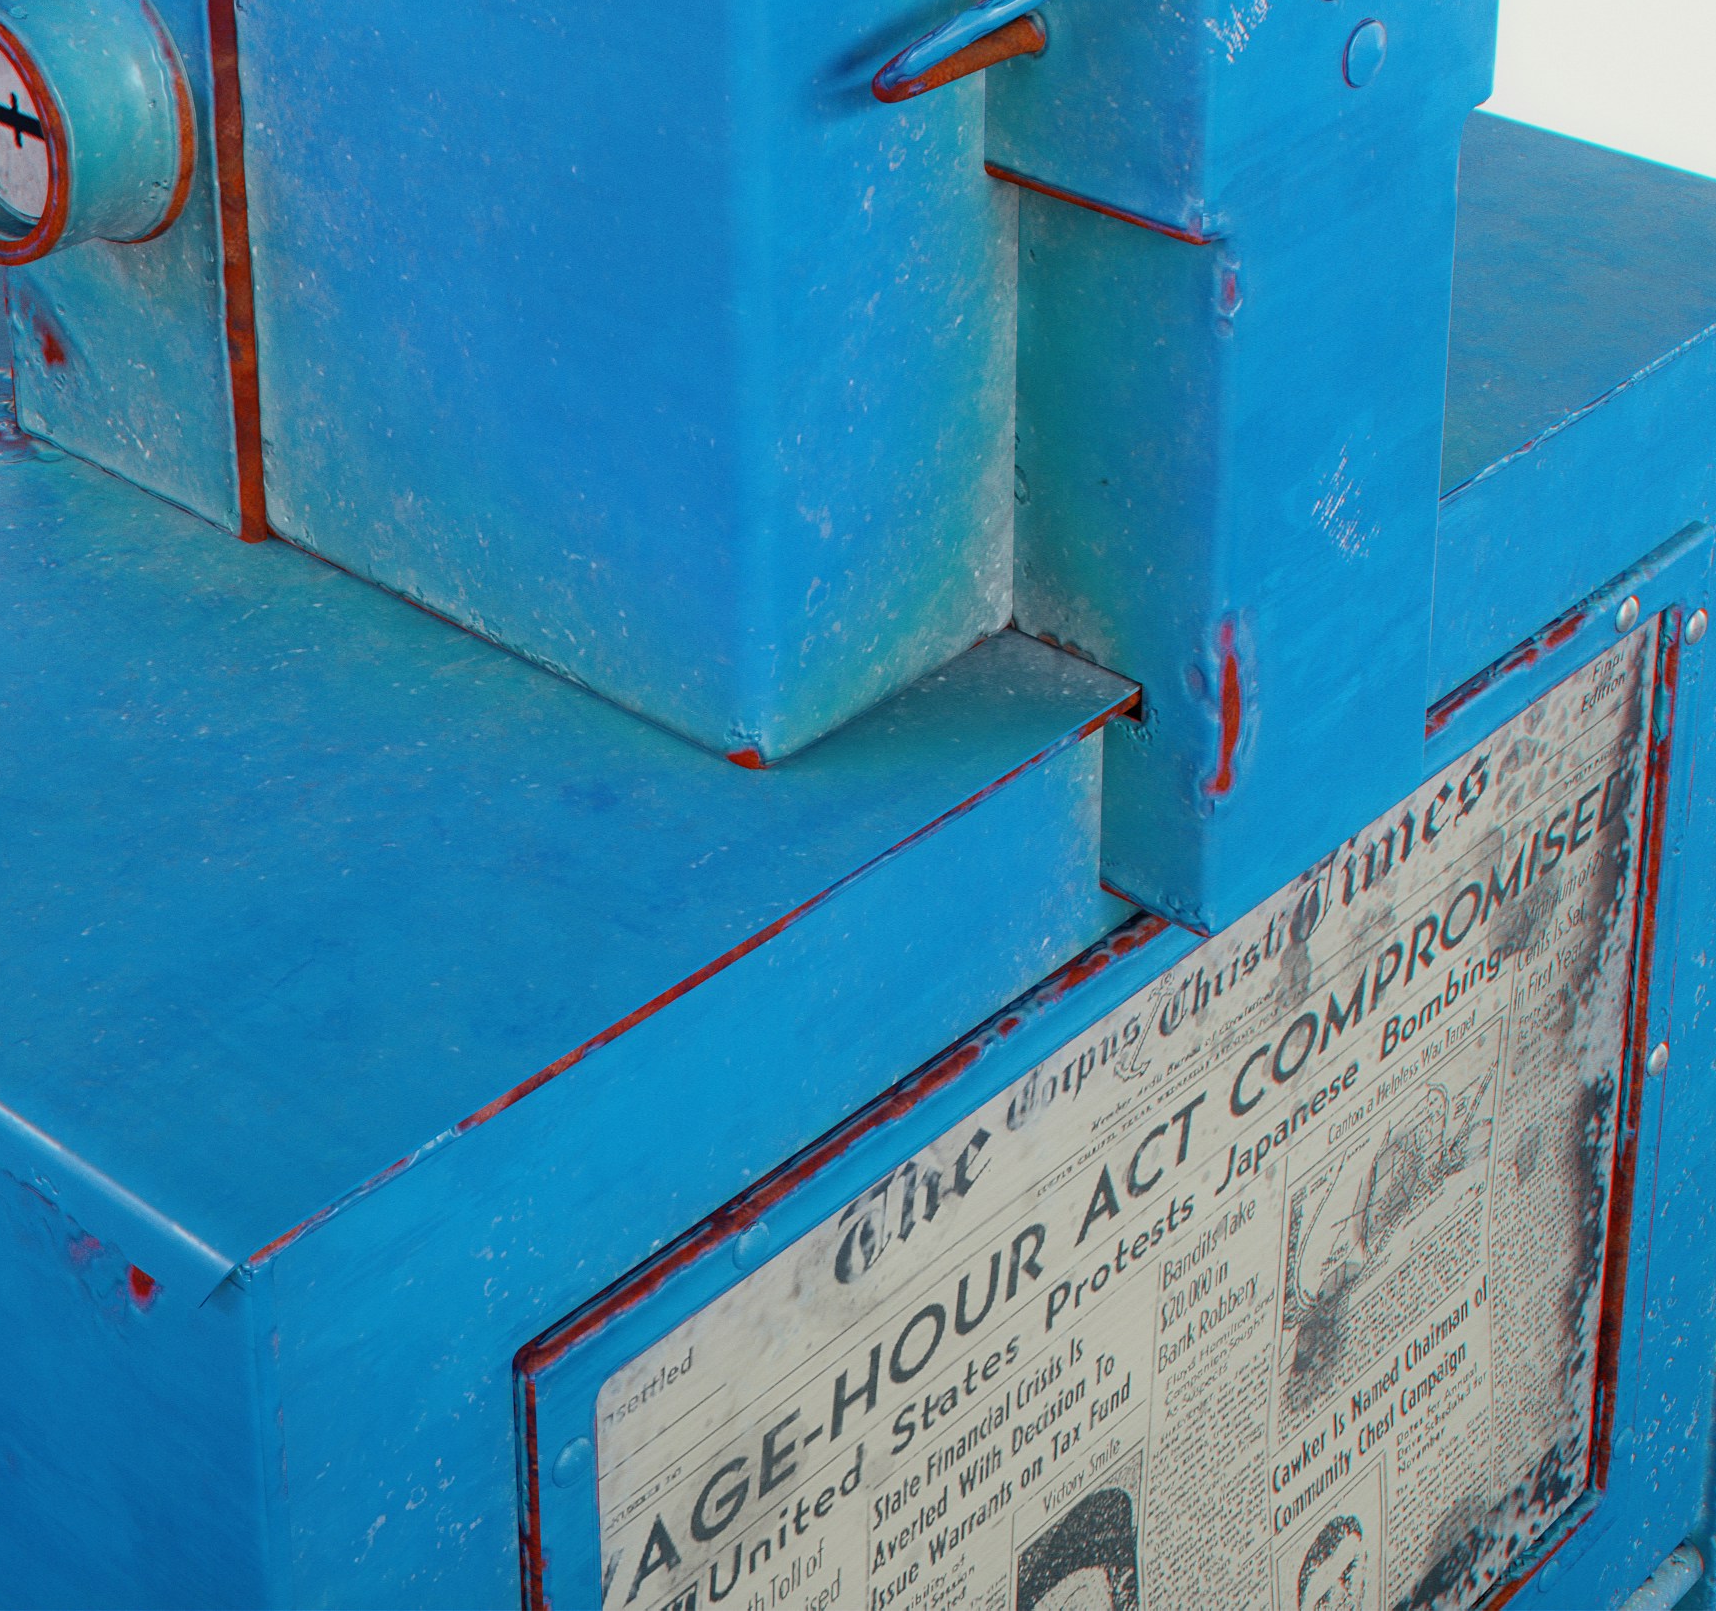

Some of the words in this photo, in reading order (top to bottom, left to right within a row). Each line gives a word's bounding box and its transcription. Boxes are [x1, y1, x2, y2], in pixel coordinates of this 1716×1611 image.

[1581, 671, 1626, 714] Edition
[1591, 651, 1624, 682] Final
[834, 1127, 992, 1284] The
[1005, 1012, 1142, 1131] Corpus
[1159, 911, 1286, 1037] Christi
[1289, 744, 1492, 943] Times
[1074, 1090, 1207, 1247] ACT
[1230, 764, 1629, 1118] COMPROMISED
[1514, 983, 1524, 1012] In
[1528, 960, 1553, 999] First
[1327, 1103, 1364, 1145] Canton
[1366, 1097, 1374, 1114] a
[1375, 1059, 1419, 1107] Helpless
[1421, 1040, 1442, 1069] War
[1444, 1008, 1477, 1050] Target
[1162, 1228, 1218, 1292] Bandits
[1223, 1198, 1256, 1241] Take
[708, 1442, 864, 1603] United
[891, 1335, 1020, 1454] States
[1045, 1194, 1195, 1333] Protests
[1214, 1061, 1360, 1197] Japanese
[1158, 1320, 1195, 1374] Bank
[1198, 1271, 1260, 1339] Robbery
[1161, 1266, 1213, 1334] $20,000
[1215, 1260, 1229, 1288] in
[601, 1345, 694, 1432] nsettled
[872, 1474, 921, 1531] State
[926, 1390, 1011, 1487] Financial
[1016, 1353, 1063, 1411] Crisis
[1069, 1337, 1084, 1368] Is
[1272, 1430, 1327, 1493] Cawker
[1332, 1411, 1346, 1440] Is
[1350, 1356, 1401, 1423] Named
[1404, 1300, 1470, 1372] Chairman
[1473, 1273, 1489, 1309] of
[871, 1485, 948, 1576] Averted
[958, 1443, 1003, 1499] With
[1011, 1377, 1085, 1458] Decision
[1095, 1352, 1114, 1387] To
[1043, 1469, 1084, 1514] Victory
[1089, 1438, 1122, 1478] Smile
[1273, 1446, 1353, 1535] Community
[1357, 1400, 1395, 1457] Chest
[1399, 1342, 1467, 1417] Campaign
[870, 1562, 920, 1611] Issue
[928, 1480, 1013, 1566] Warrants
[1020, 1455, 1044, 1490] on
[1050, 1421, 1082, 1463] Tax
[1088, 1370, 1131, 1431] Fund
[769, 1556, 802, 1608] Toll
[805, 1537, 825, 1579] of
[906, 1573, 947, 1611] ibility
